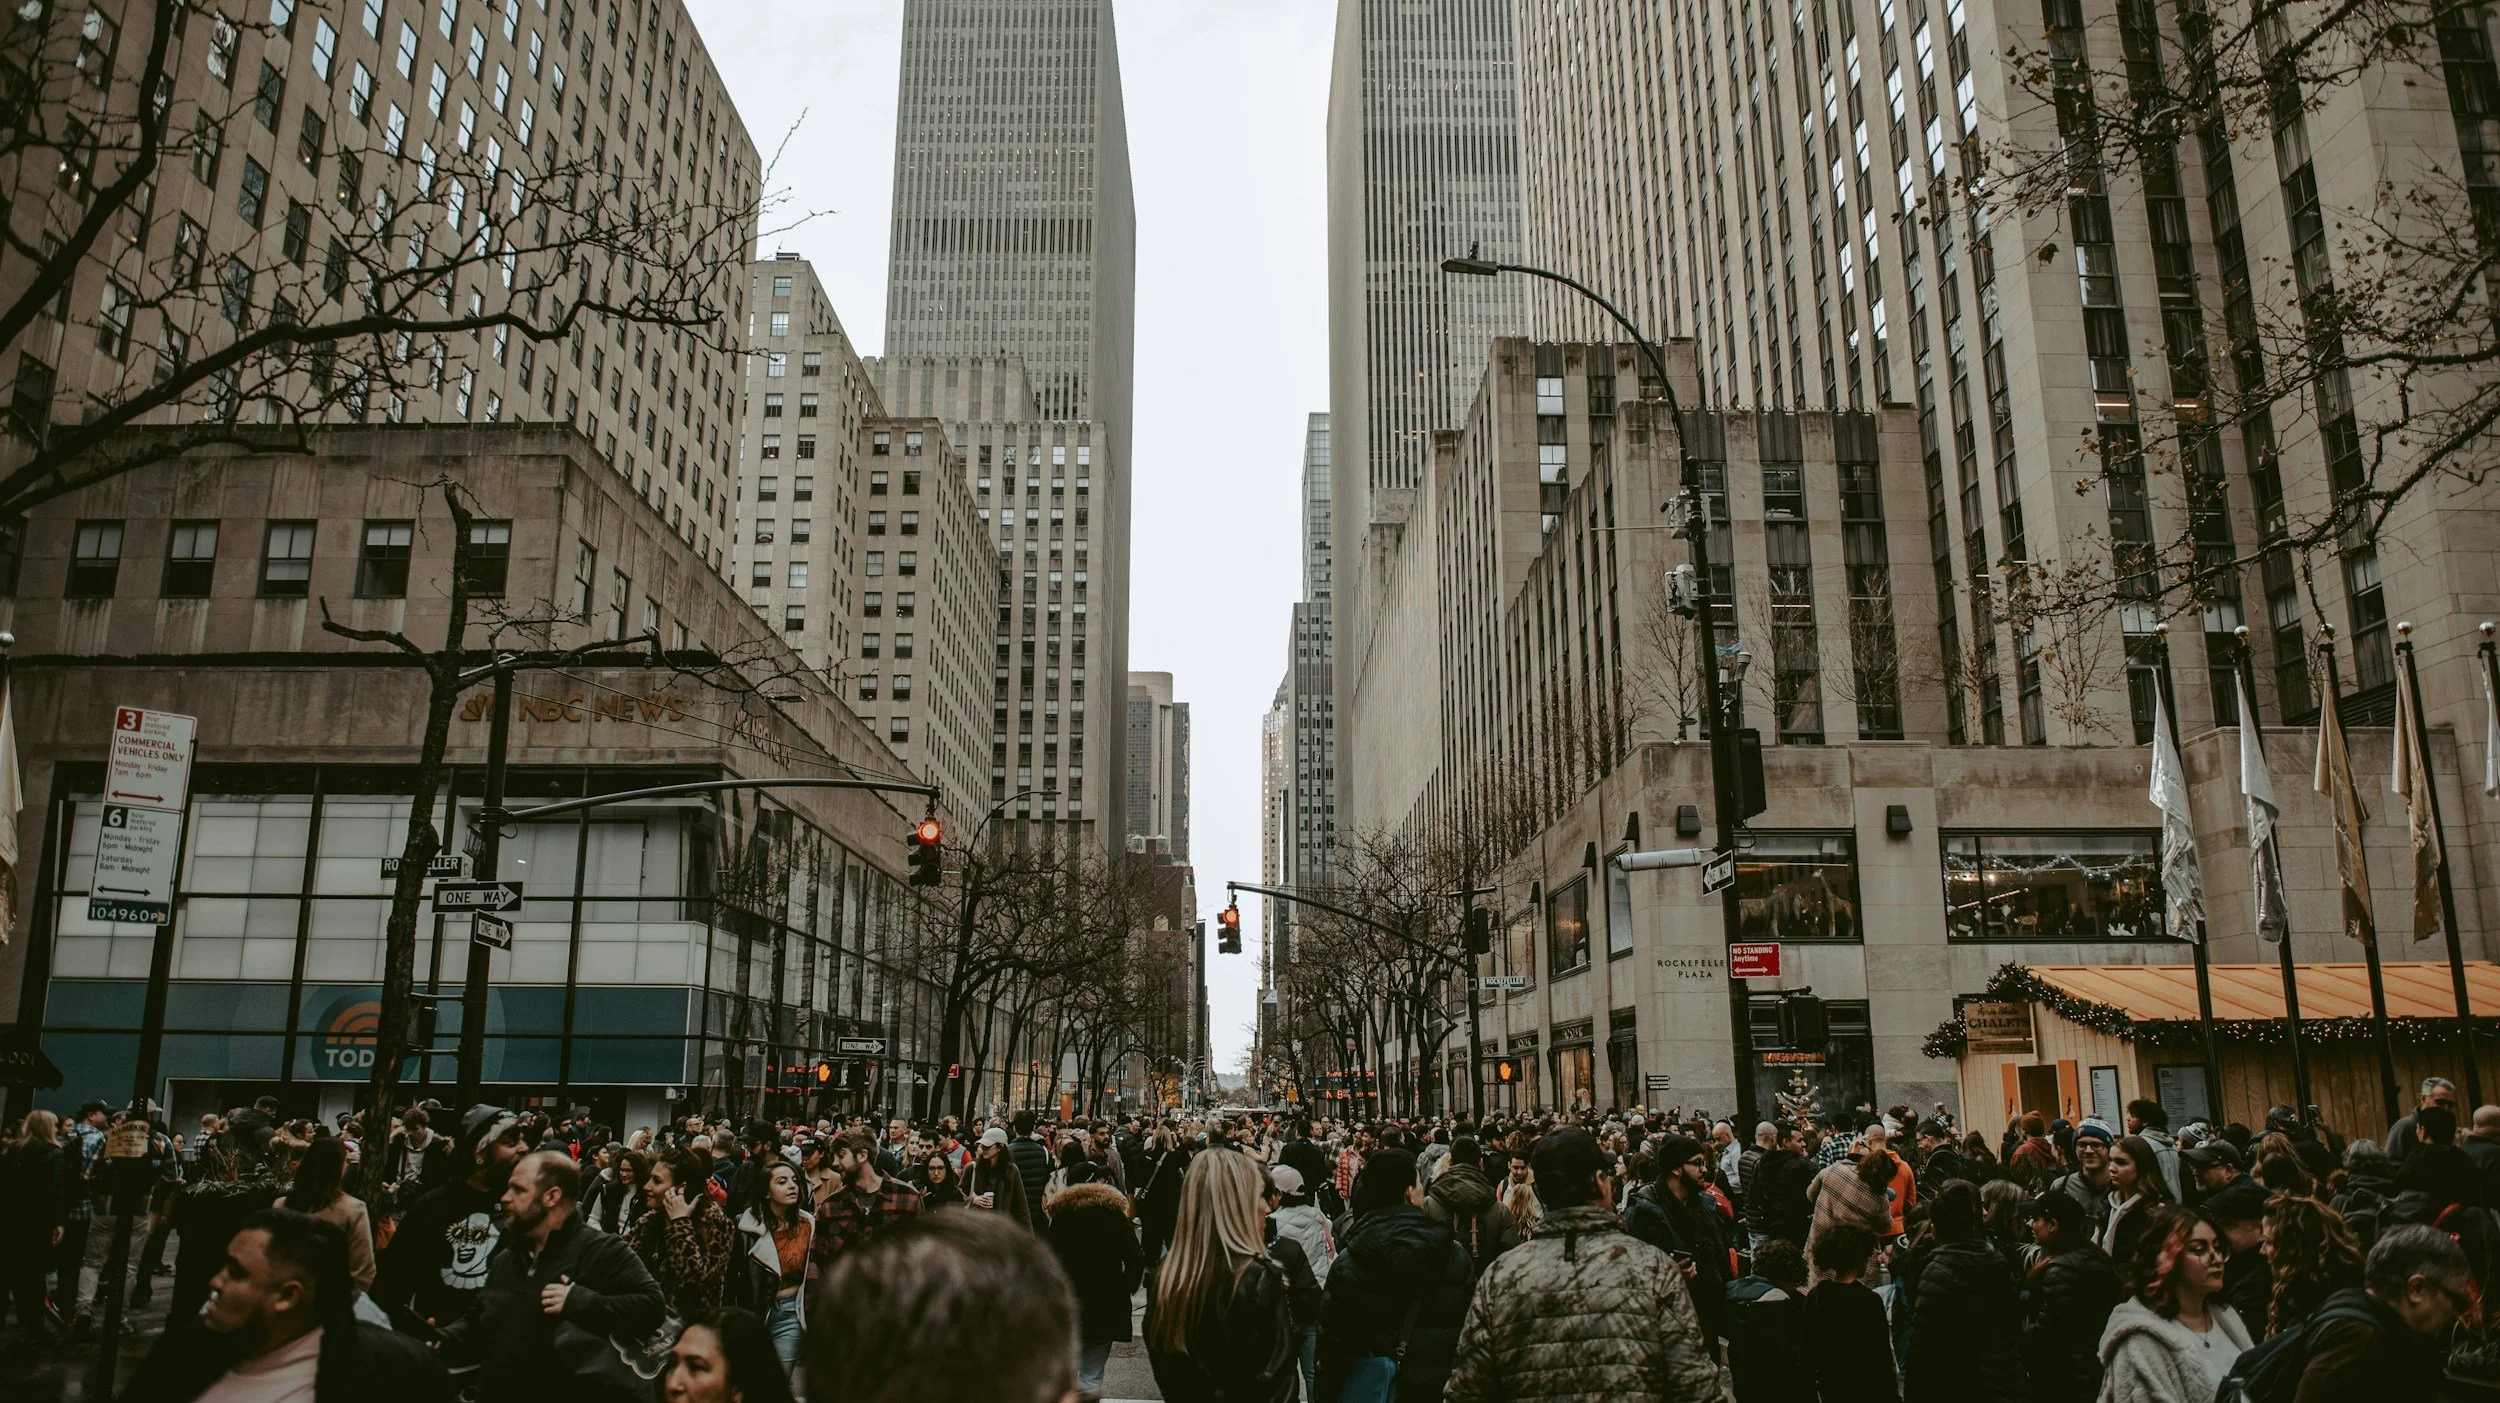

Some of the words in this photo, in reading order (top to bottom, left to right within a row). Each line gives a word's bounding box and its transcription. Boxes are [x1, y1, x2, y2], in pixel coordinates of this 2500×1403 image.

[518, 694, 583, 722] NBC
[594, 694, 686, 723] NEWS
[122, 712, 136, 730] 3
[118, 736, 176, 751] COMMERCIAL
[118, 746, 160, 759] VEHICLES
[162, 752, 184, 762] ONLY
[114, 760, 140, 770] Monday
[148, 764, 168, 774] Friday
[114, 768, 128, 776] 7am
[136, 771, 152, 779] 6pm
[108, 808, 122, 826] 6
[104, 833, 132, 842] Monday
[139, 837, 160, 846] Friday
[102, 842, 118, 850] 6pm
[125, 844, 153, 854] Midnight
[101, 854, 133, 863] Saturday
[384, 858, 458, 871] ROLLER
[121, 864, 150, 874] Midnight
[446, 892, 472, 903] ONE
[483, 891, 510, 903] WAY
[1734, 955, 1758, 963] Anytime
[325, 1050, 375, 1068] TOD
